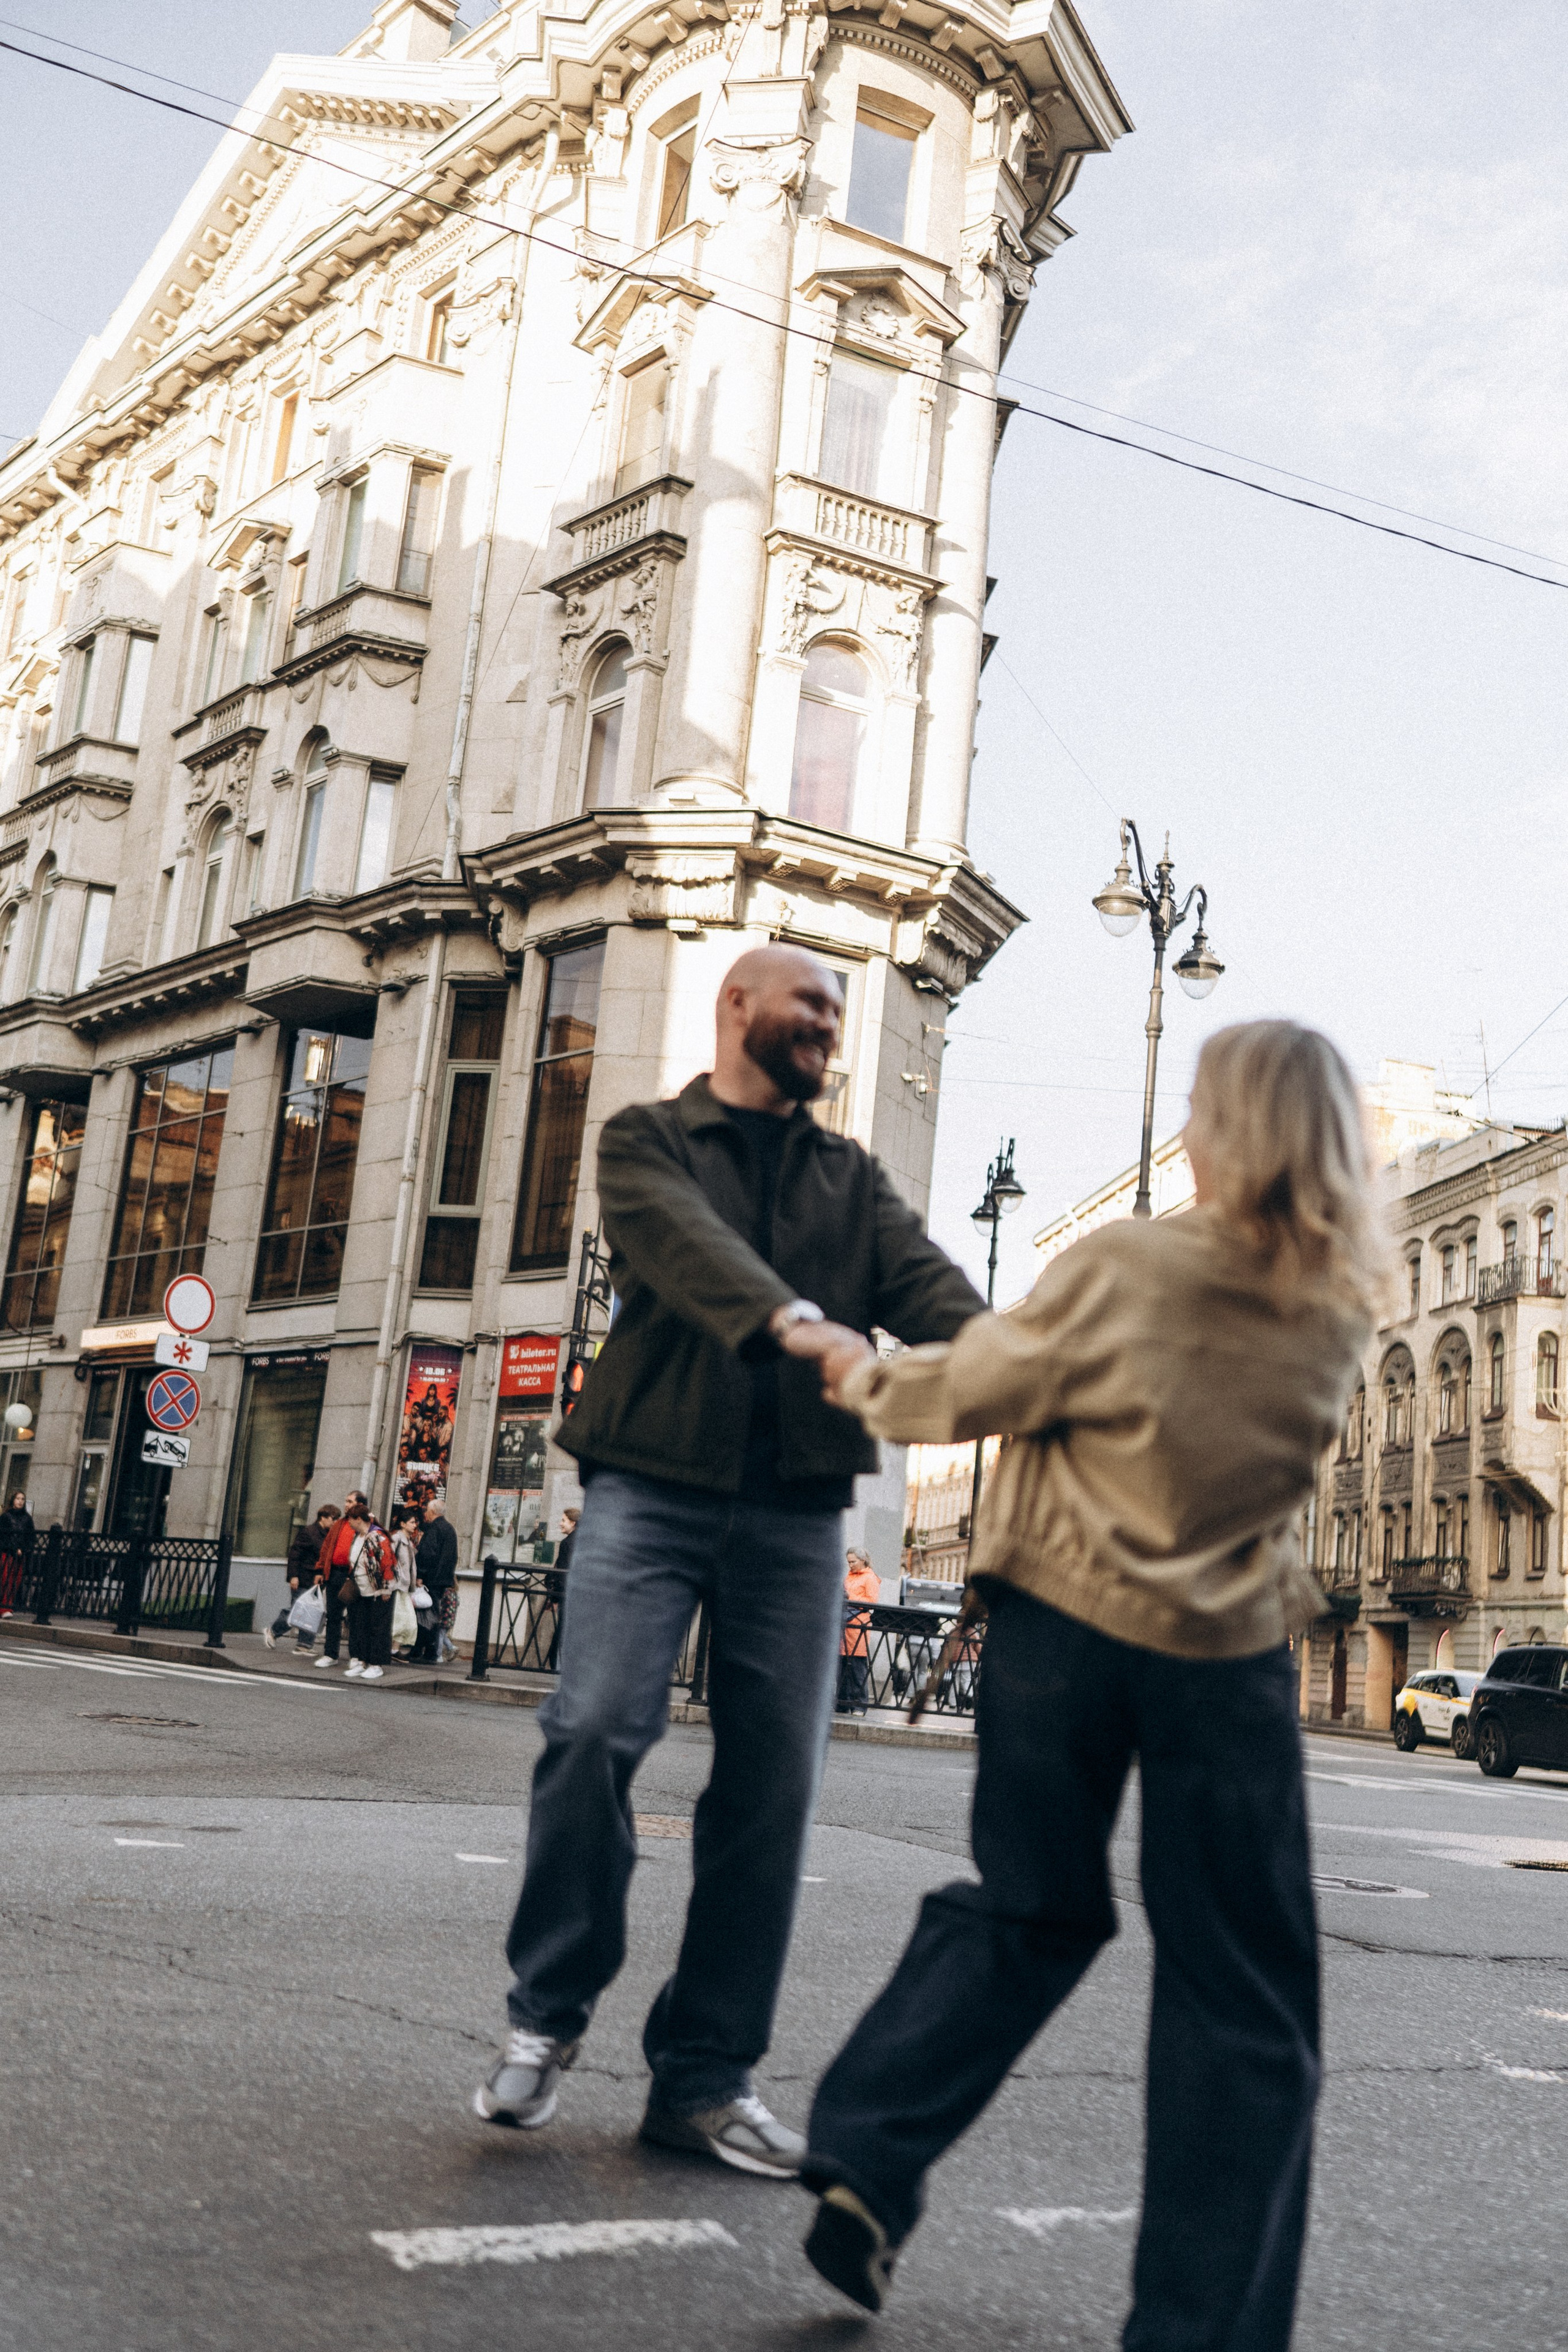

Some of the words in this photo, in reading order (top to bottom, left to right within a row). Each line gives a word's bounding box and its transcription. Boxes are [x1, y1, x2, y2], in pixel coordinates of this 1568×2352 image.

[116, 1329, 137, 1339] FORBS
[521, 1348, 556, 1358] bileter.ru
[252, 1357, 270, 1366] FORBS
[508, 1363, 556, 1374] ТЕАТРАЛЬНАЯ
[519, 1376, 541, 1386] КАССА
